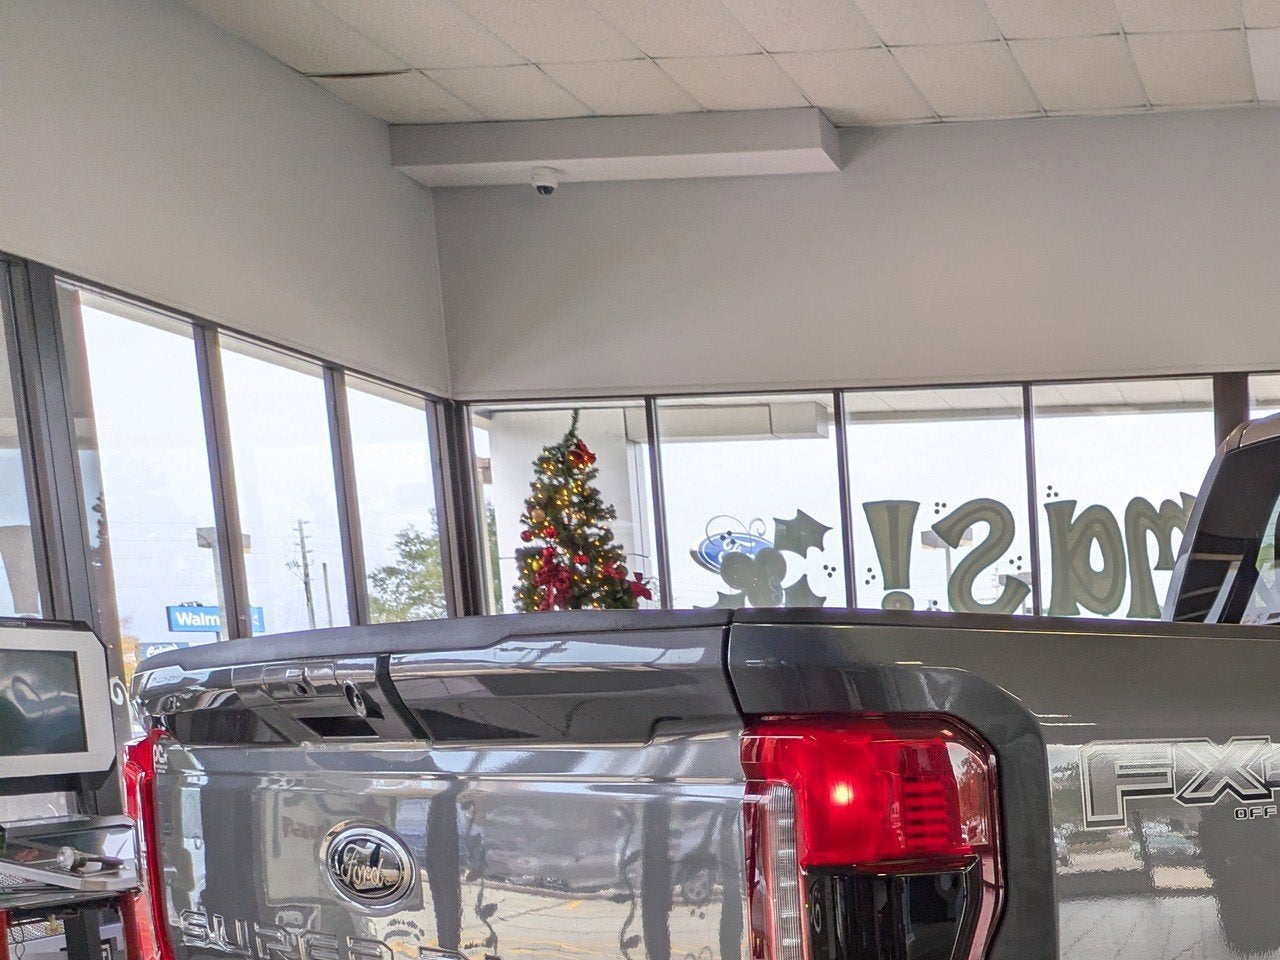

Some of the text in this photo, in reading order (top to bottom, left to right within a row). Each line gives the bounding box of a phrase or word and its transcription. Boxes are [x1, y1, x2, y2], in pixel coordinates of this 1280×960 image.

[175, 611, 220, 627] Walm
[1234, 805, 1277, 821] OFF
[341, 843, 385, 886] Ford
